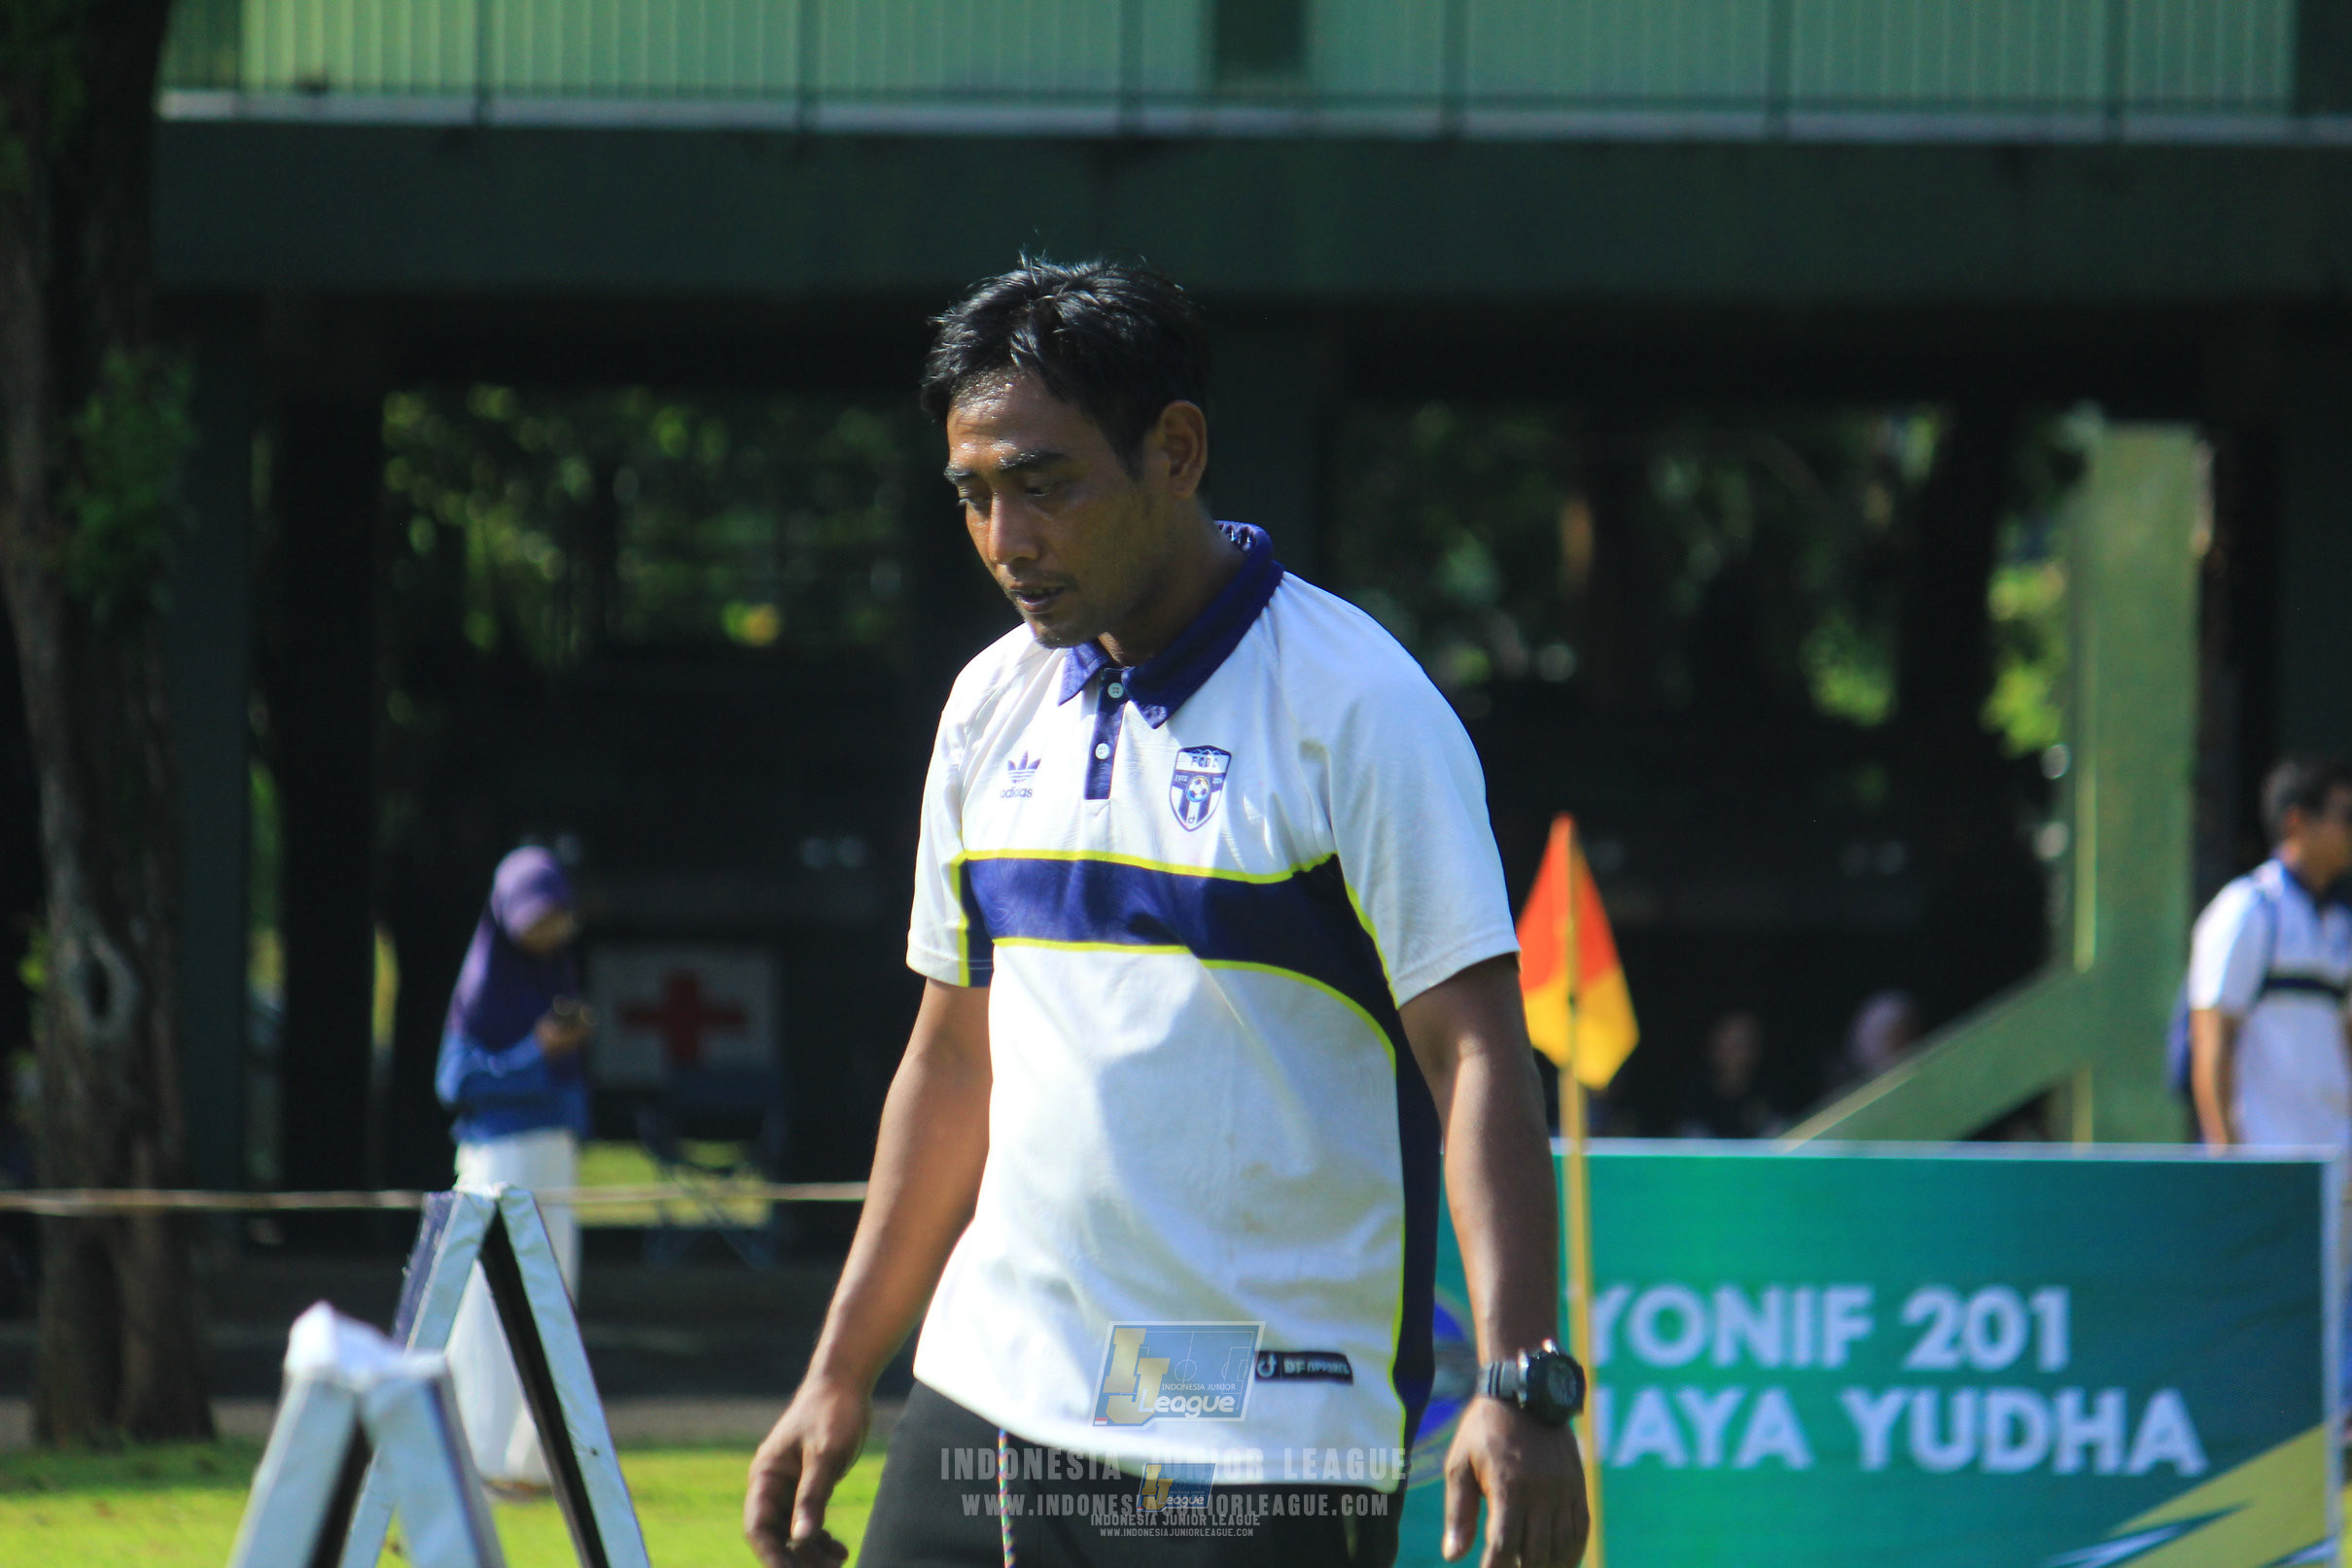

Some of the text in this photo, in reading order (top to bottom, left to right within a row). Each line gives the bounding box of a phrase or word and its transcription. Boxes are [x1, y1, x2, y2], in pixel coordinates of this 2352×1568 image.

[1000, 786, 1034, 798] adidas
[1568, 1282, 2071, 1373] YONIF 201
[1837, 1384, 2209, 1478] YUDHA
